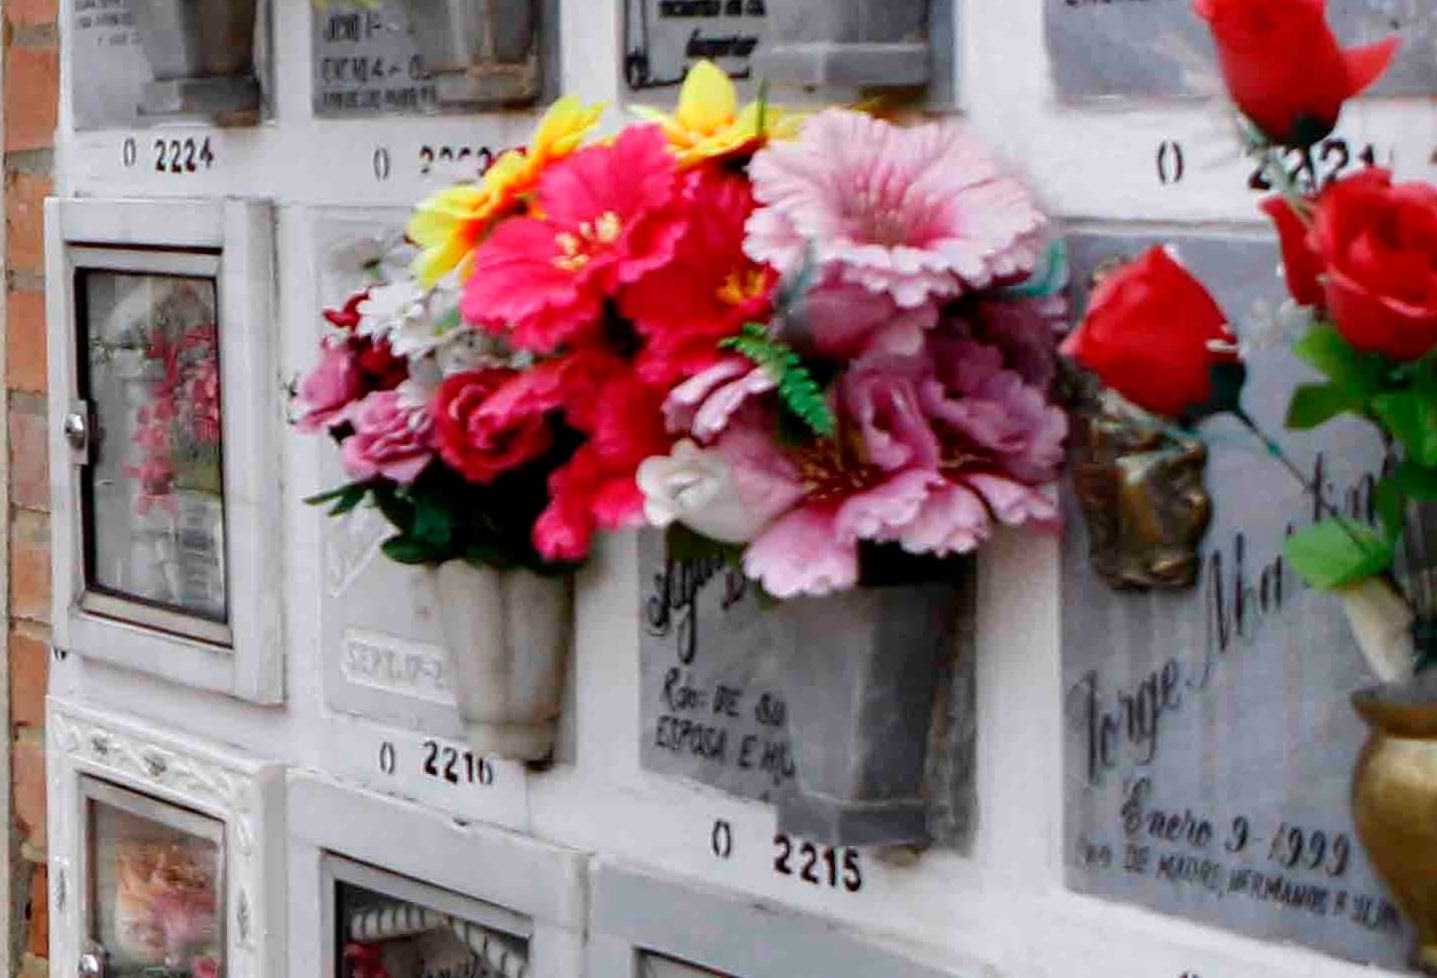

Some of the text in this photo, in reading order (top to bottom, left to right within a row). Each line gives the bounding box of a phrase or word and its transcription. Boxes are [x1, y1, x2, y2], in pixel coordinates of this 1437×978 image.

[154, 137, 215, 173] 2224
[738, 735, 757, 770] E
[772, 830, 864, 893] 2215
